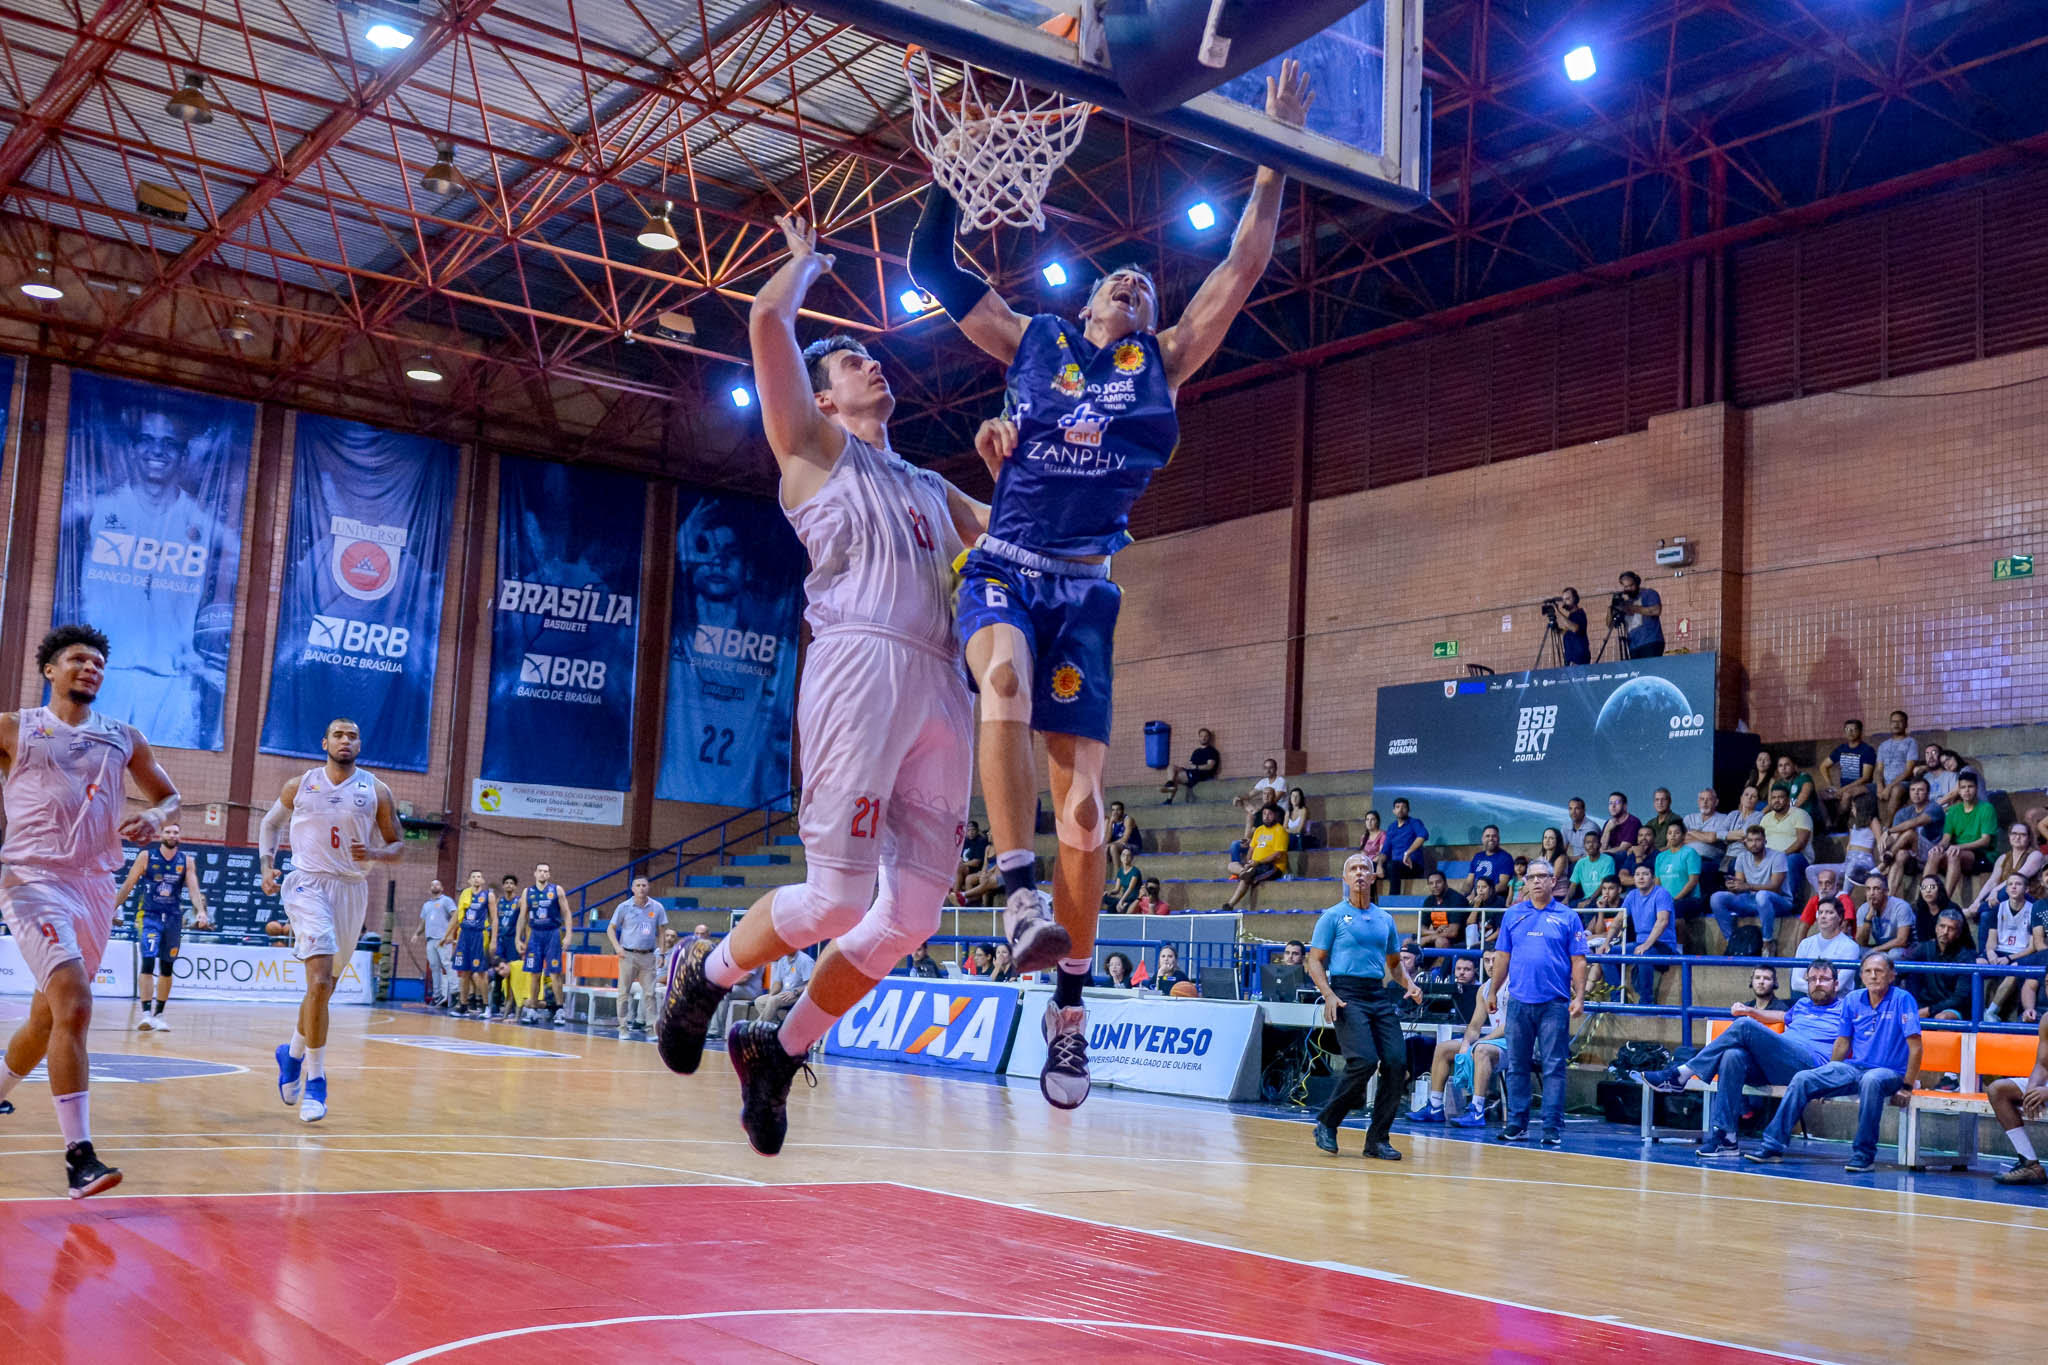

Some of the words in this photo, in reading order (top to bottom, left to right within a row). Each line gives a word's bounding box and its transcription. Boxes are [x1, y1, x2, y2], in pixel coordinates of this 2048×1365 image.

[1097, 393, 1136, 402] CAMPOS
[1103, 378, 1135, 394] JOSÉ
[1066, 430, 1100, 444] card
[1026, 441, 1126, 469] ZANPHY
[335, 521, 407, 544] UNIVERSO
[133, 537, 208, 577] BRB
[88, 568, 131, 584] BANCO
[499, 579, 633, 626] BRASÍLIA
[985, 583, 1009, 608] 6
[543, 619, 588, 632] BASQUETE
[343, 620, 410, 658] BRB
[722, 629, 777, 663] BRB
[304, 649, 342, 665] BANCO
[343, 656, 357, 667] DE
[359, 658, 403, 673] BRASÍLIA
[550, 656, 607, 690] BRB
[517, 686, 550, 699] BANCO
[551, 689, 563, 700] DE
[564, 691, 602, 704] BRASÍLIA
[1517, 704, 1558, 730] BSB
[699, 724, 735, 766] 22
[1388, 745, 1417, 755] QUADRA
[1514, 728, 1555, 753] BKT
[1512, 752, 1546, 762] .com.br
[851, 797, 880, 839] 21
[331, 826, 340, 848] 6
[42, 923, 59, 945] 9
[148, 939, 156, 952] 7
[837, 989, 1000, 1062] CAIXA
[1090, 1023, 1213, 1056] UNIVERSO
[1088, 1055, 1130, 1064] NIVERSIDADE
[1130, 1057, 1161, 1068] SALGADO
[1162, 1060, 1172, 1068] DE
[1173, 1061, 1202, 1071] OLIVEIRA
